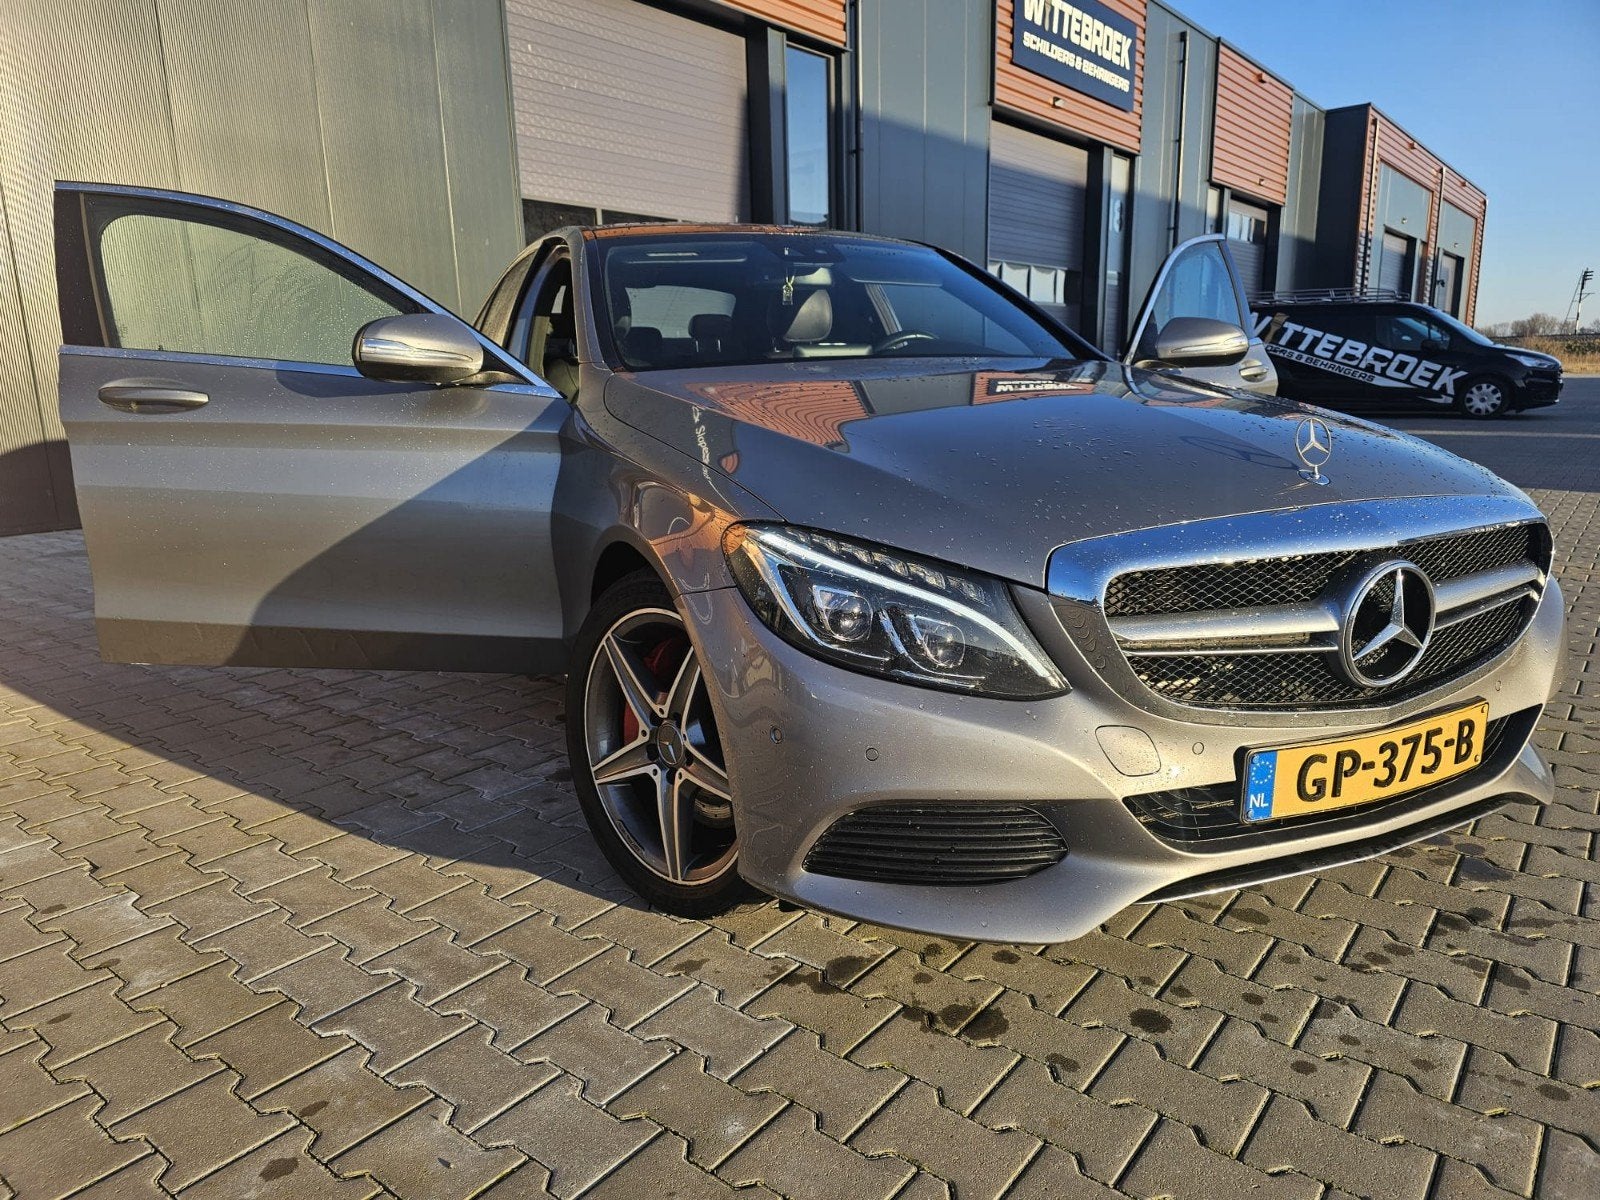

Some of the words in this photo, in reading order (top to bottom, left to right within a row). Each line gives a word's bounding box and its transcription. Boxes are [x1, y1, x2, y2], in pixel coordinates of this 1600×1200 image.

[1023, 31, 1076, 67] SCHILDERS
[1075, 55, 1083, 71] &
[1082, 59, 1131, 93] BEHANGERS
[1304, 357, 1376, 382] BEHANGERS
[1297, 718, 1476, 803] GP-375-B
[1249, 792, 1269, 808] NL
